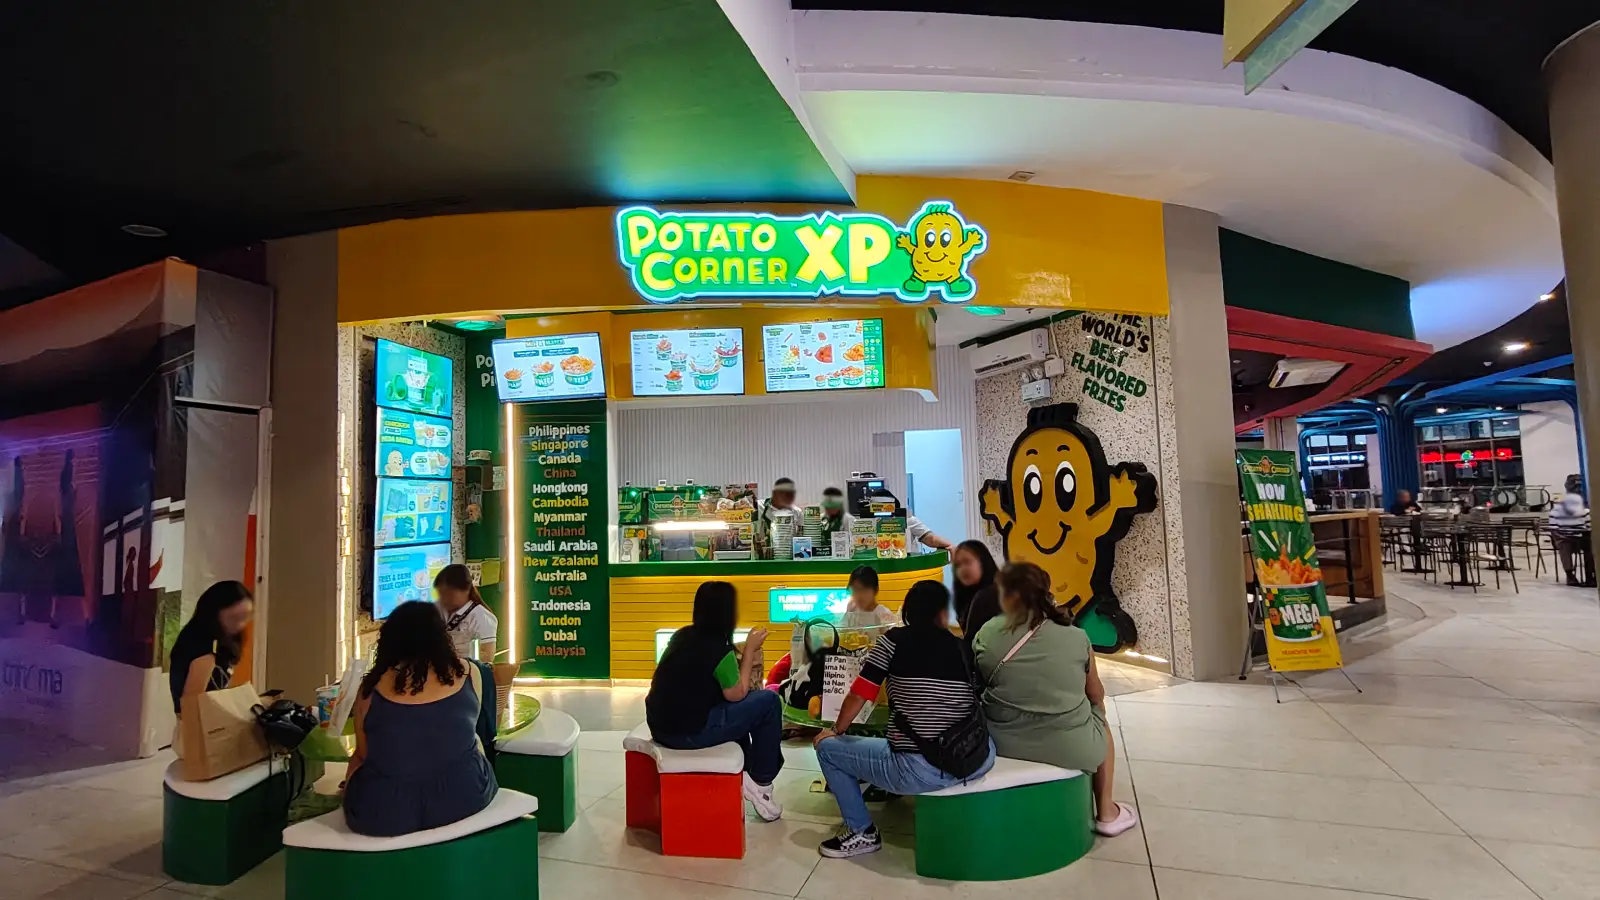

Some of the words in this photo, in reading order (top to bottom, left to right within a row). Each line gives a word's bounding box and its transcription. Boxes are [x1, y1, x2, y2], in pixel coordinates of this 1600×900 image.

[628, 215, 777, 258] POTATO
[795, 223, 891, 284] XP
[641, 252, 788, 291] CORNER
[1080, 314, 1150, 353] WORLD'S
[1089, 339, 1129, 368] BEST
[481, 371, 499, 388] Pi
[1070, 352, 1147, 398] FLAVORED
[1081, 377, 1127, 413] FRIES
[528, 424, 590, 439] Philippines
[531, 439, 588, 453] Singapore
[538, 452, 582, 465] Canada
[543, 467, 577, 478] China
[532, 482, 588, 495] Hongkong
[1256, 483, 1286, 501] NOW
[532, 495, 589, 508] Cambodia
[533, 512, 587, 525] Myanmar
[1247, 503, 1305, 523] SHAKING
[536, 525, 585, 537] Thailand
[523, 540, 555, 552] Saudi
[559, 539, 598, 551] Arabia
[552, 554, 599, 566] Zealand
[535, 570, 587, 581] Australia
[549, 586, 572, 596] USA
[531, 599, 591, 611] Indonesia
[540, 614, 581, 626] London
[1279, 604, 1321, 627] MEGA
[543, 629, 577, 641] Dubai
[536, 644, 585, 659] Malaysia
